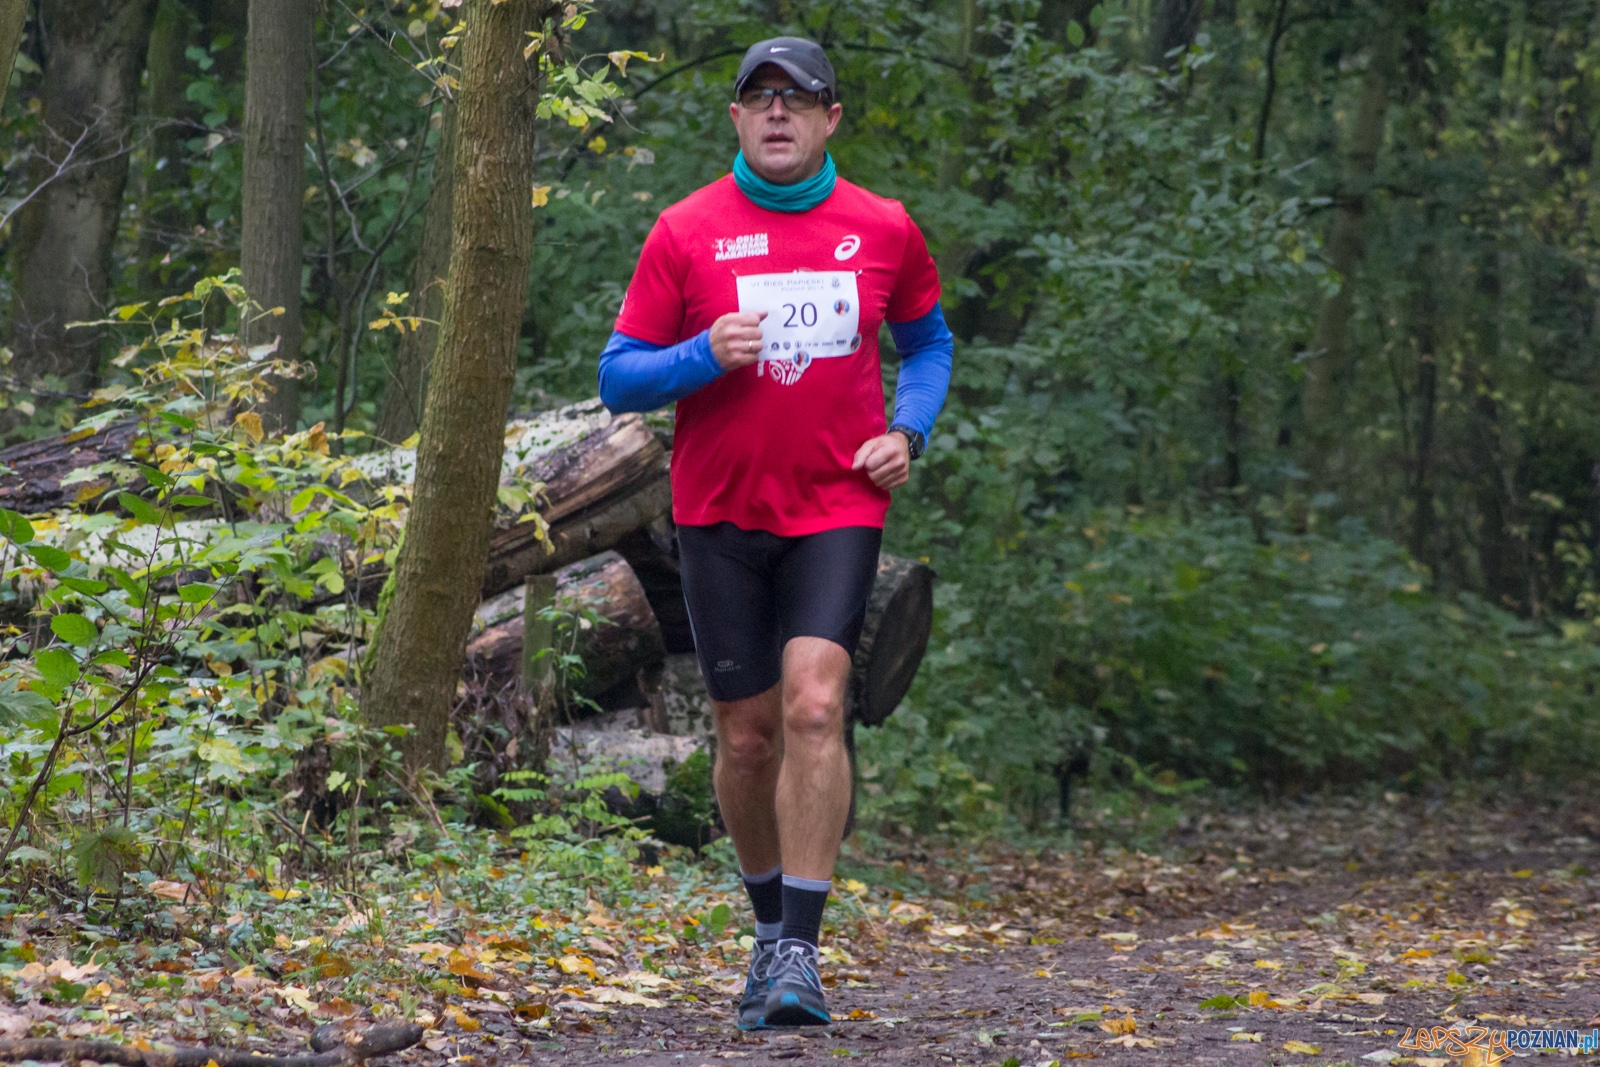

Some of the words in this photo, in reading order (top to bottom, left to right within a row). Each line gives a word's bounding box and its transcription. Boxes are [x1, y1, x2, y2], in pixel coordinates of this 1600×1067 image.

[735, 233, 768, 244] ORLEN
[715, 246, 769, 260] MARATHON
[782, 302, 818, 328] 20
